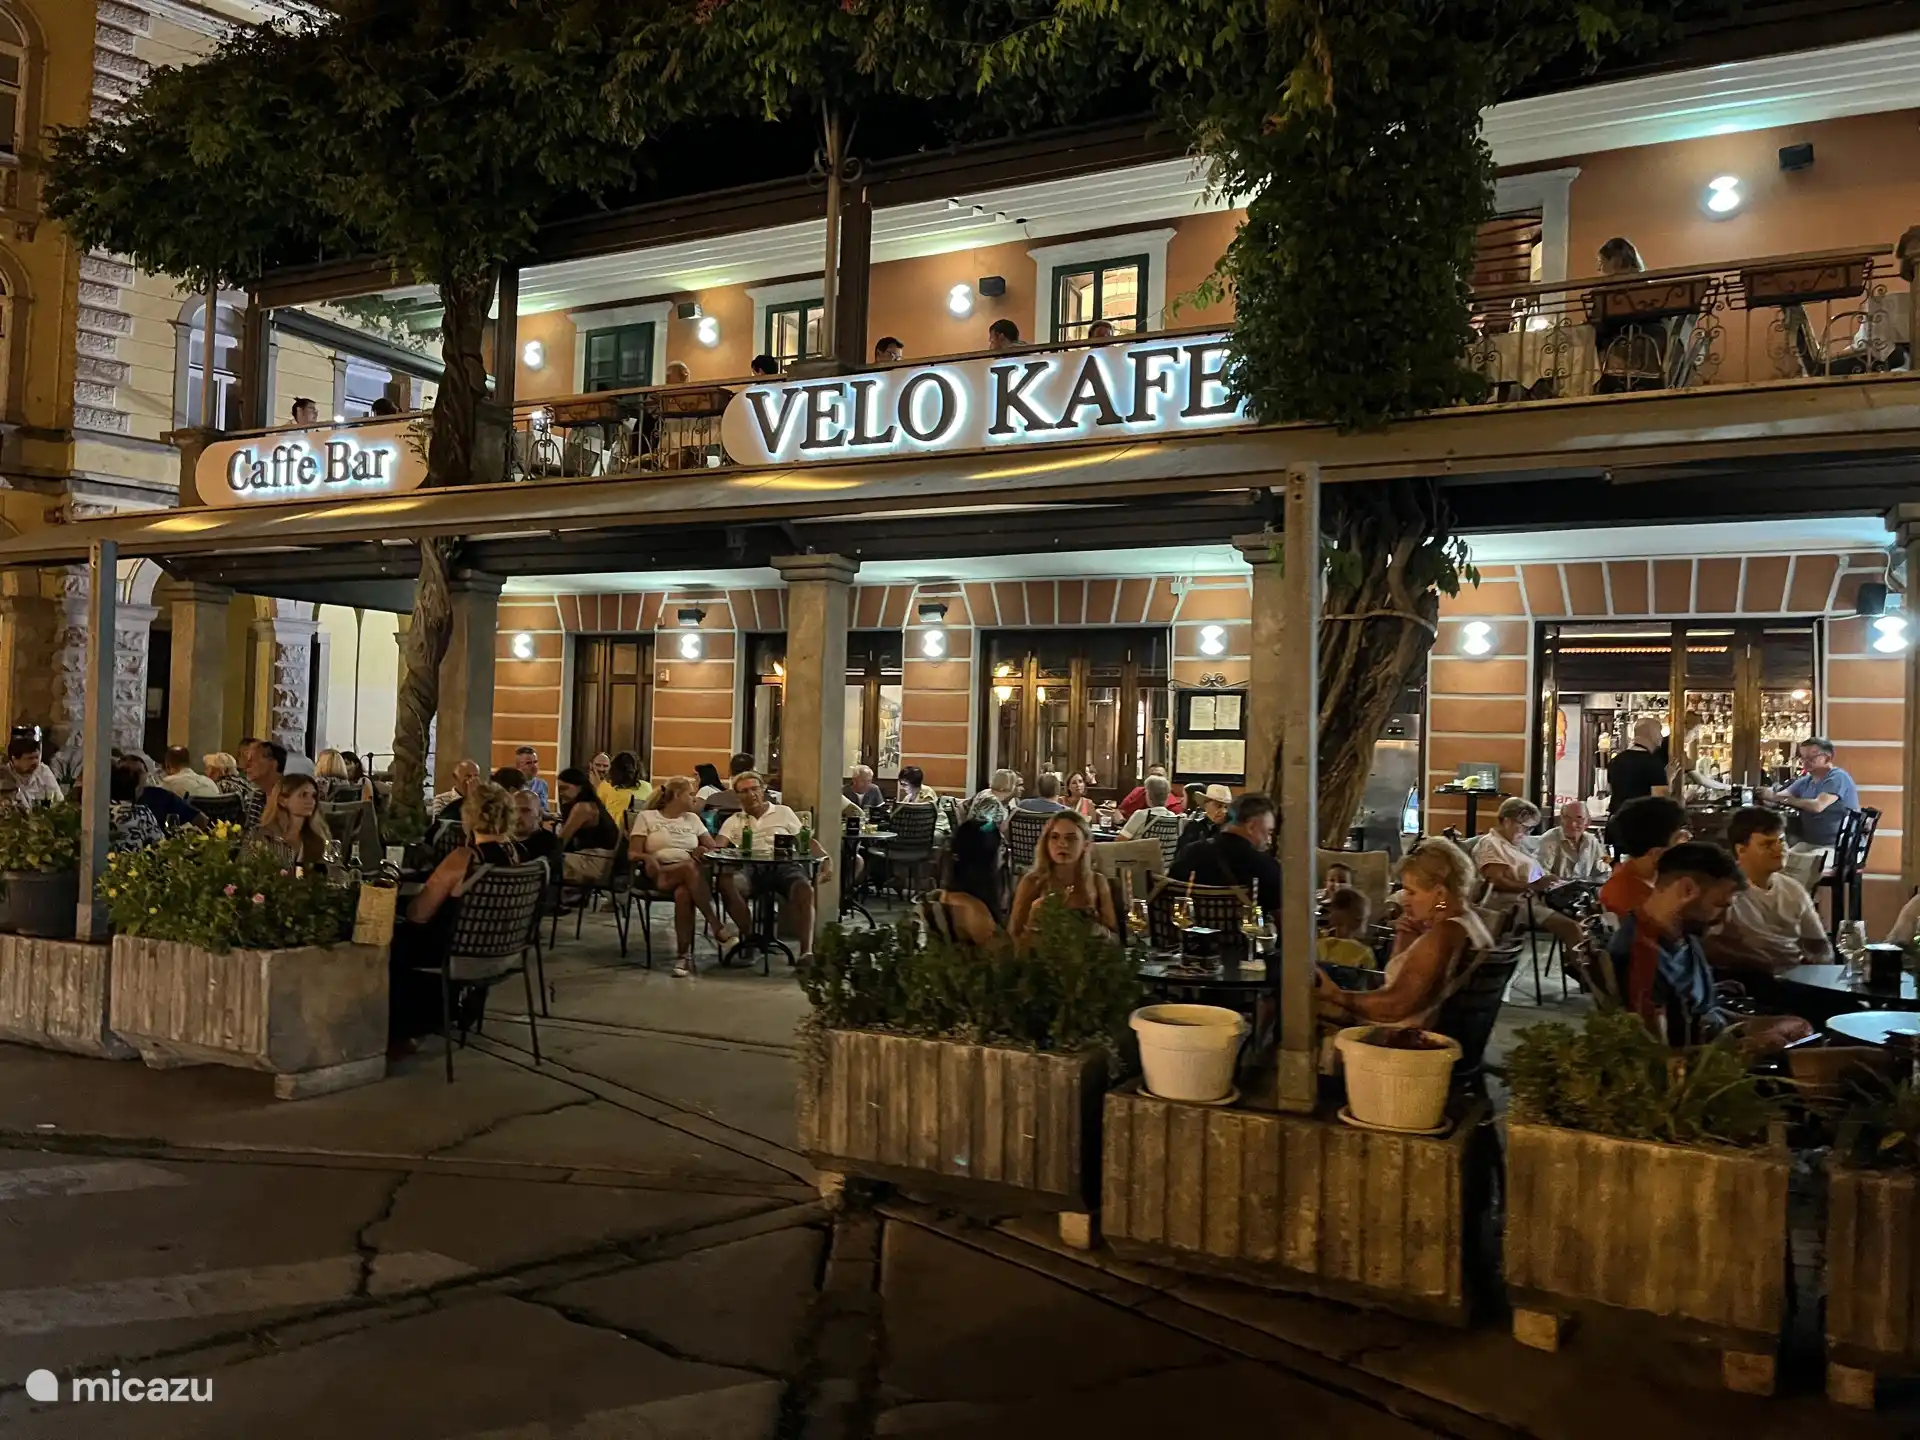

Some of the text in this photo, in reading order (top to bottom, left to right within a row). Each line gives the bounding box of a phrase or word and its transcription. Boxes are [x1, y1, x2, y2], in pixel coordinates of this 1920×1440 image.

[746, 342, 1240, 454] VELO KAFE
[226, 441, 388, 491] Caffe Bar
